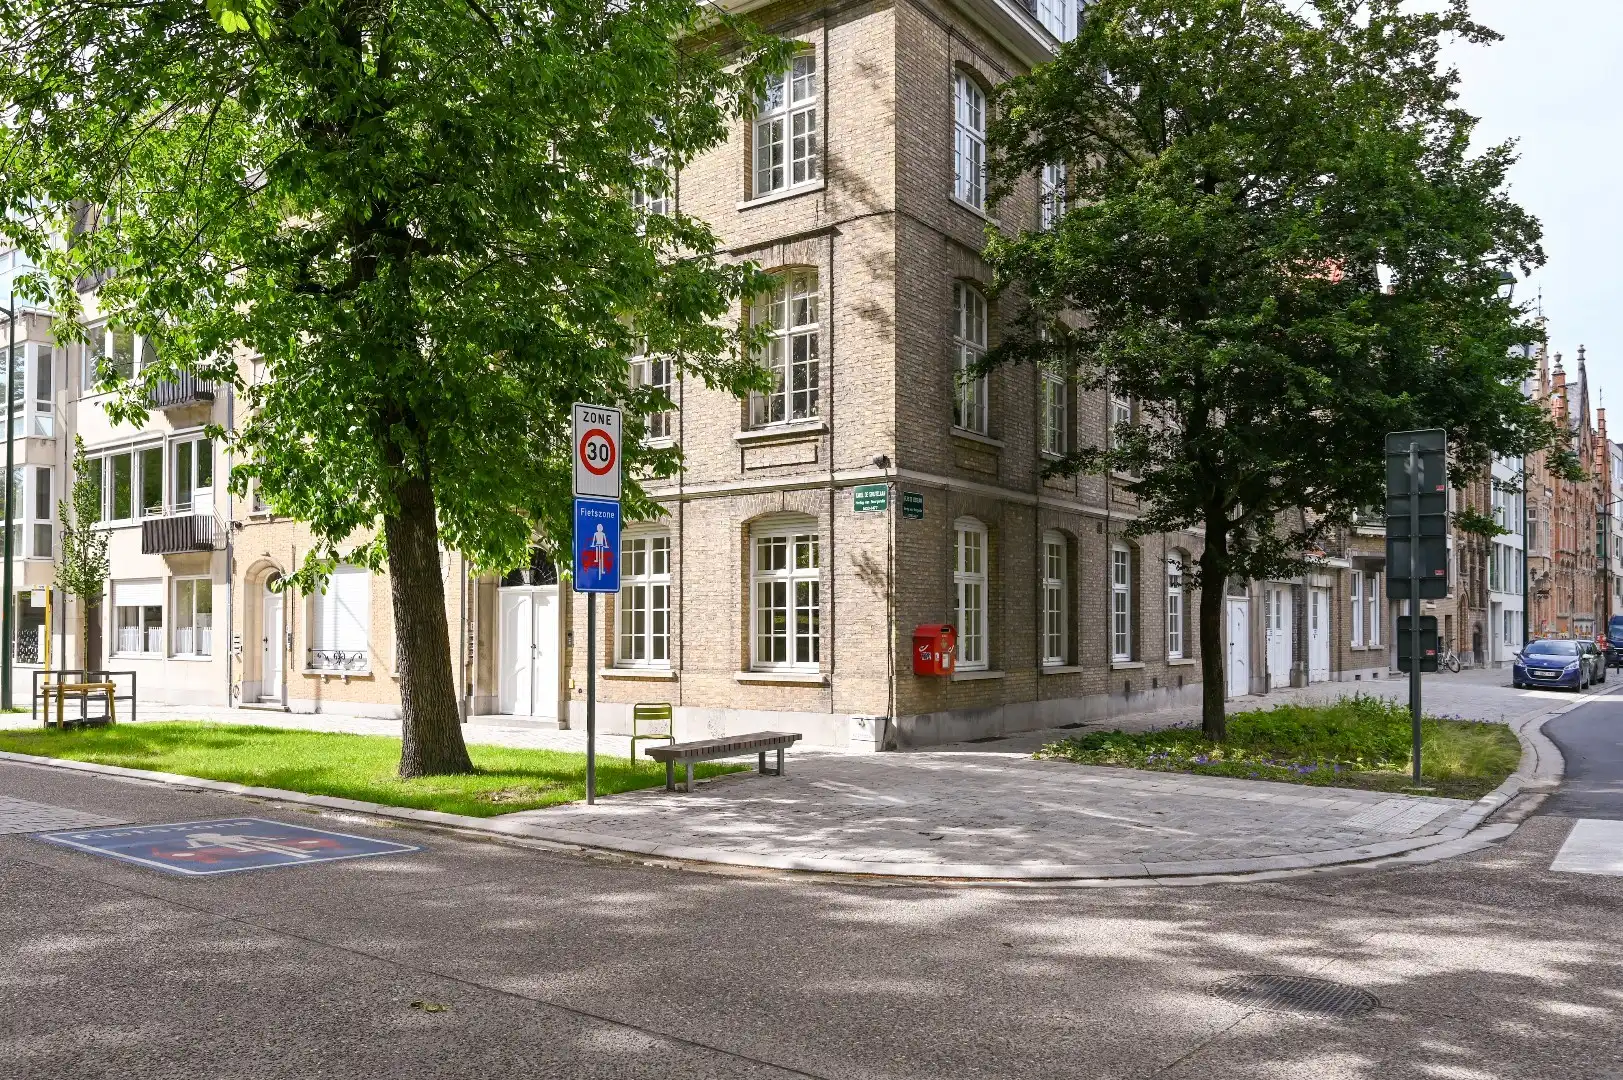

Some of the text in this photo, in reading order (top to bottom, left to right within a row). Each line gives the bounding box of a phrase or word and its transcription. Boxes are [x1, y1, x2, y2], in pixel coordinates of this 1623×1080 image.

[583, 411, 612, 426] ZONE
[587, 442, 609, 462] 30
[580, 507, 615, 519] Fietszone
